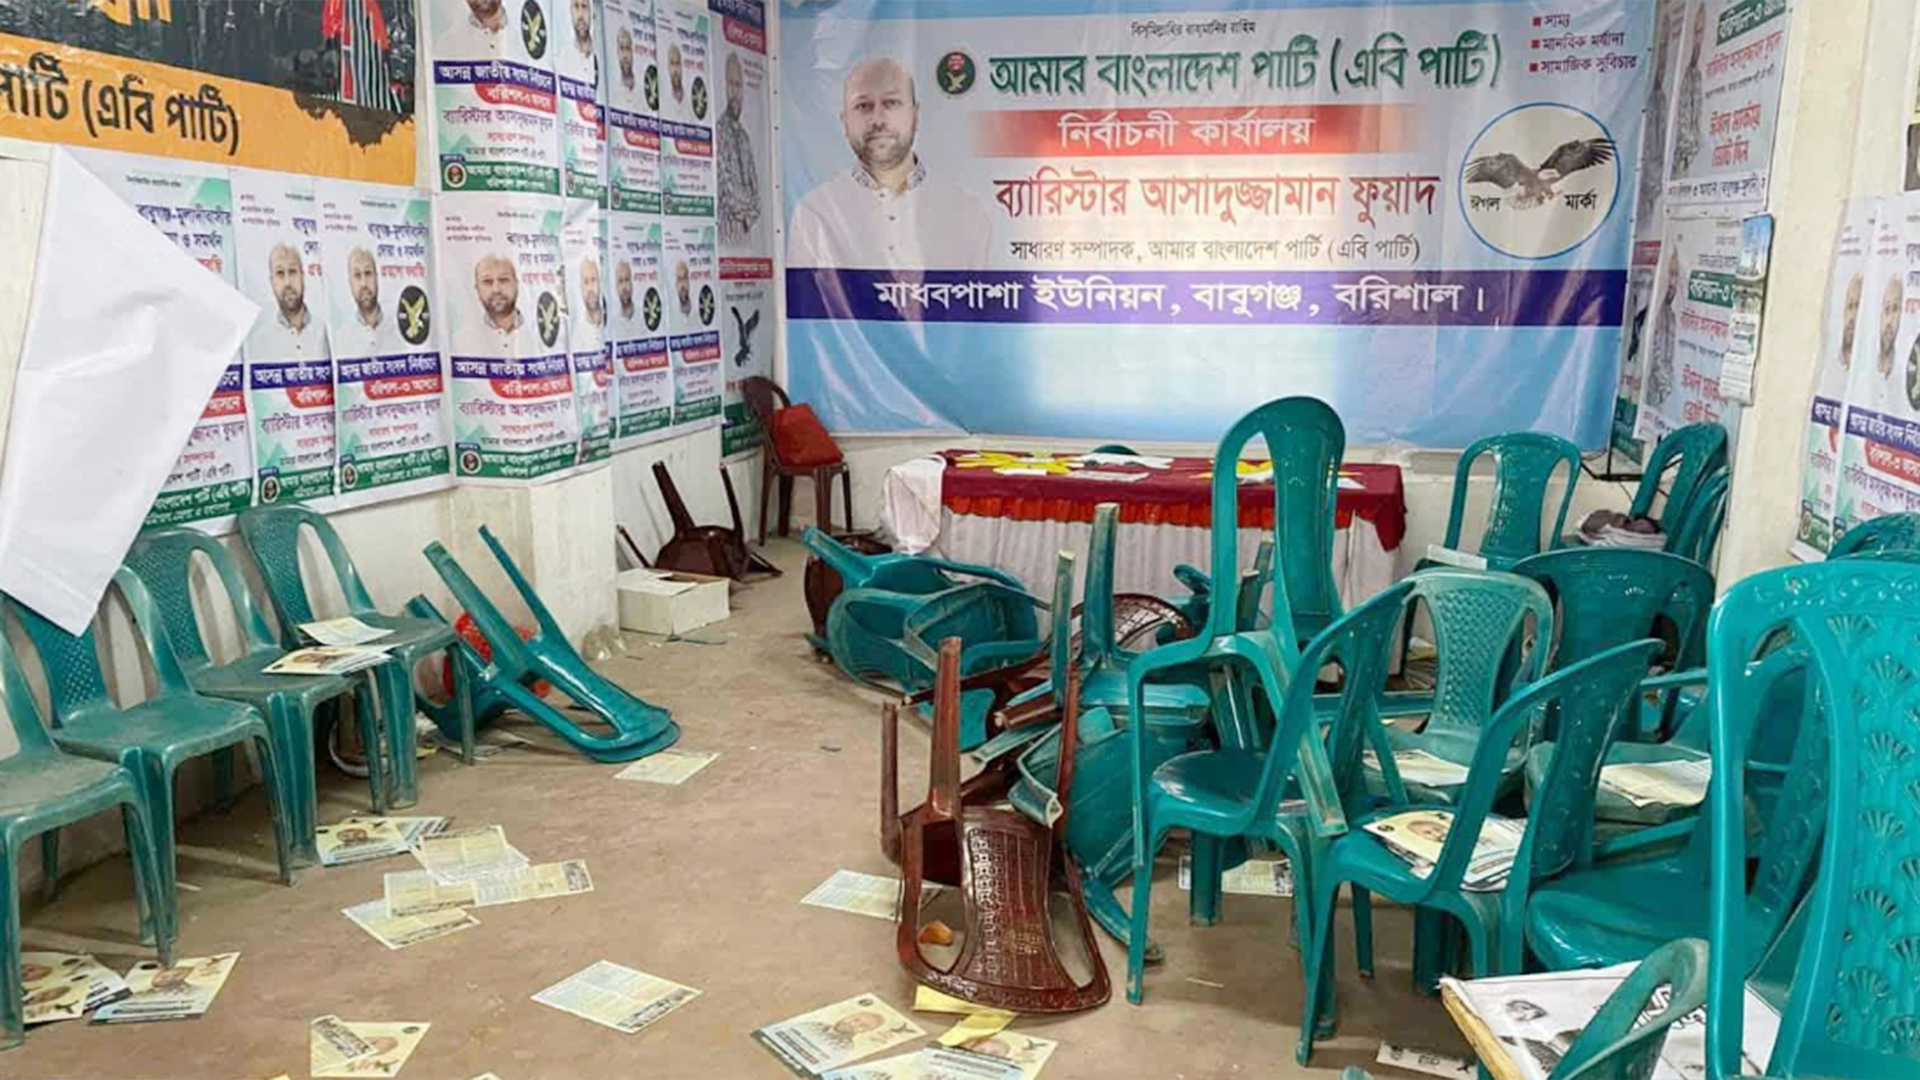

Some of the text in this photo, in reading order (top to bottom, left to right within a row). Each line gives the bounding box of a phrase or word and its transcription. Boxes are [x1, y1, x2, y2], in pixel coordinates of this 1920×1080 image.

[989, 29, 1501, 96] আমার বাংলাদেশ পার্টি (এবি পার্টি)
[82, 73, 155, 139] (এবি
[165, 83, 240, 157] পার্টি)
[1057, 107, 1316, 150] নির্বাচনী কার্যালয়
[992, 165, 1441, 229] ব্যারিস্টার আসাদুজ্জামান ফুয়াদ
[1563, 188, 1598, 211] মার্কা
[1010, 239, 1065, 261] সাধারণ
[1148, 239, 1197, 261] আমার
[1202, 238, 1279, 262] বাংলাদেশ
[1284, 233, 1323, 260] পার্টি
[1327, 233, 1370, 263] (এবি
[1374, 232, 1421, 264] পার্টি)
[872, 280, 1023, 311] মাধবপাশা
